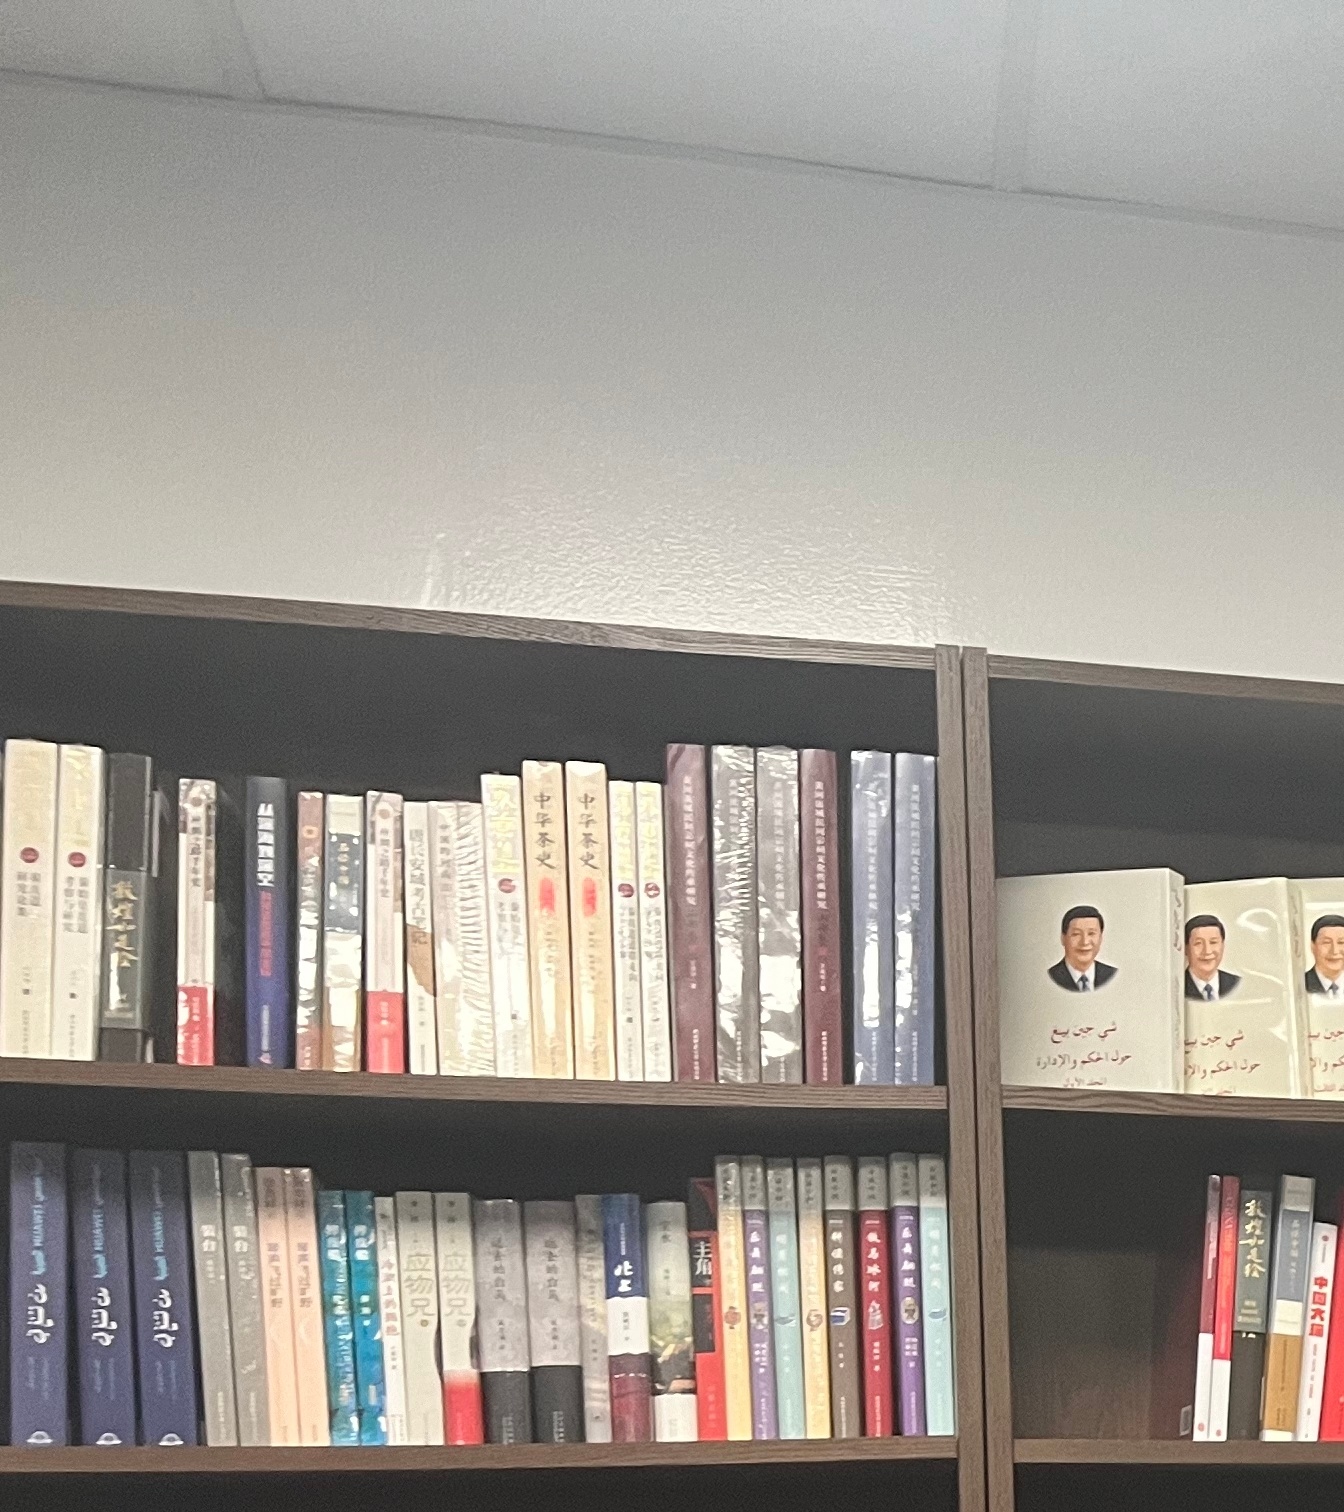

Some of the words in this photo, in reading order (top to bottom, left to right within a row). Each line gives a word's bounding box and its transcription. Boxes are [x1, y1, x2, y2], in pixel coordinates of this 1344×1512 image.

[533, 792, 556, 870] 中华茶史
[577, 792, 600, 870] 中华茶史
[404, 1251, 436, 1318] 应物兄
[441, 1251, 472, 1318] 应物兄
[613, 1260, 634, 1293] 北上
